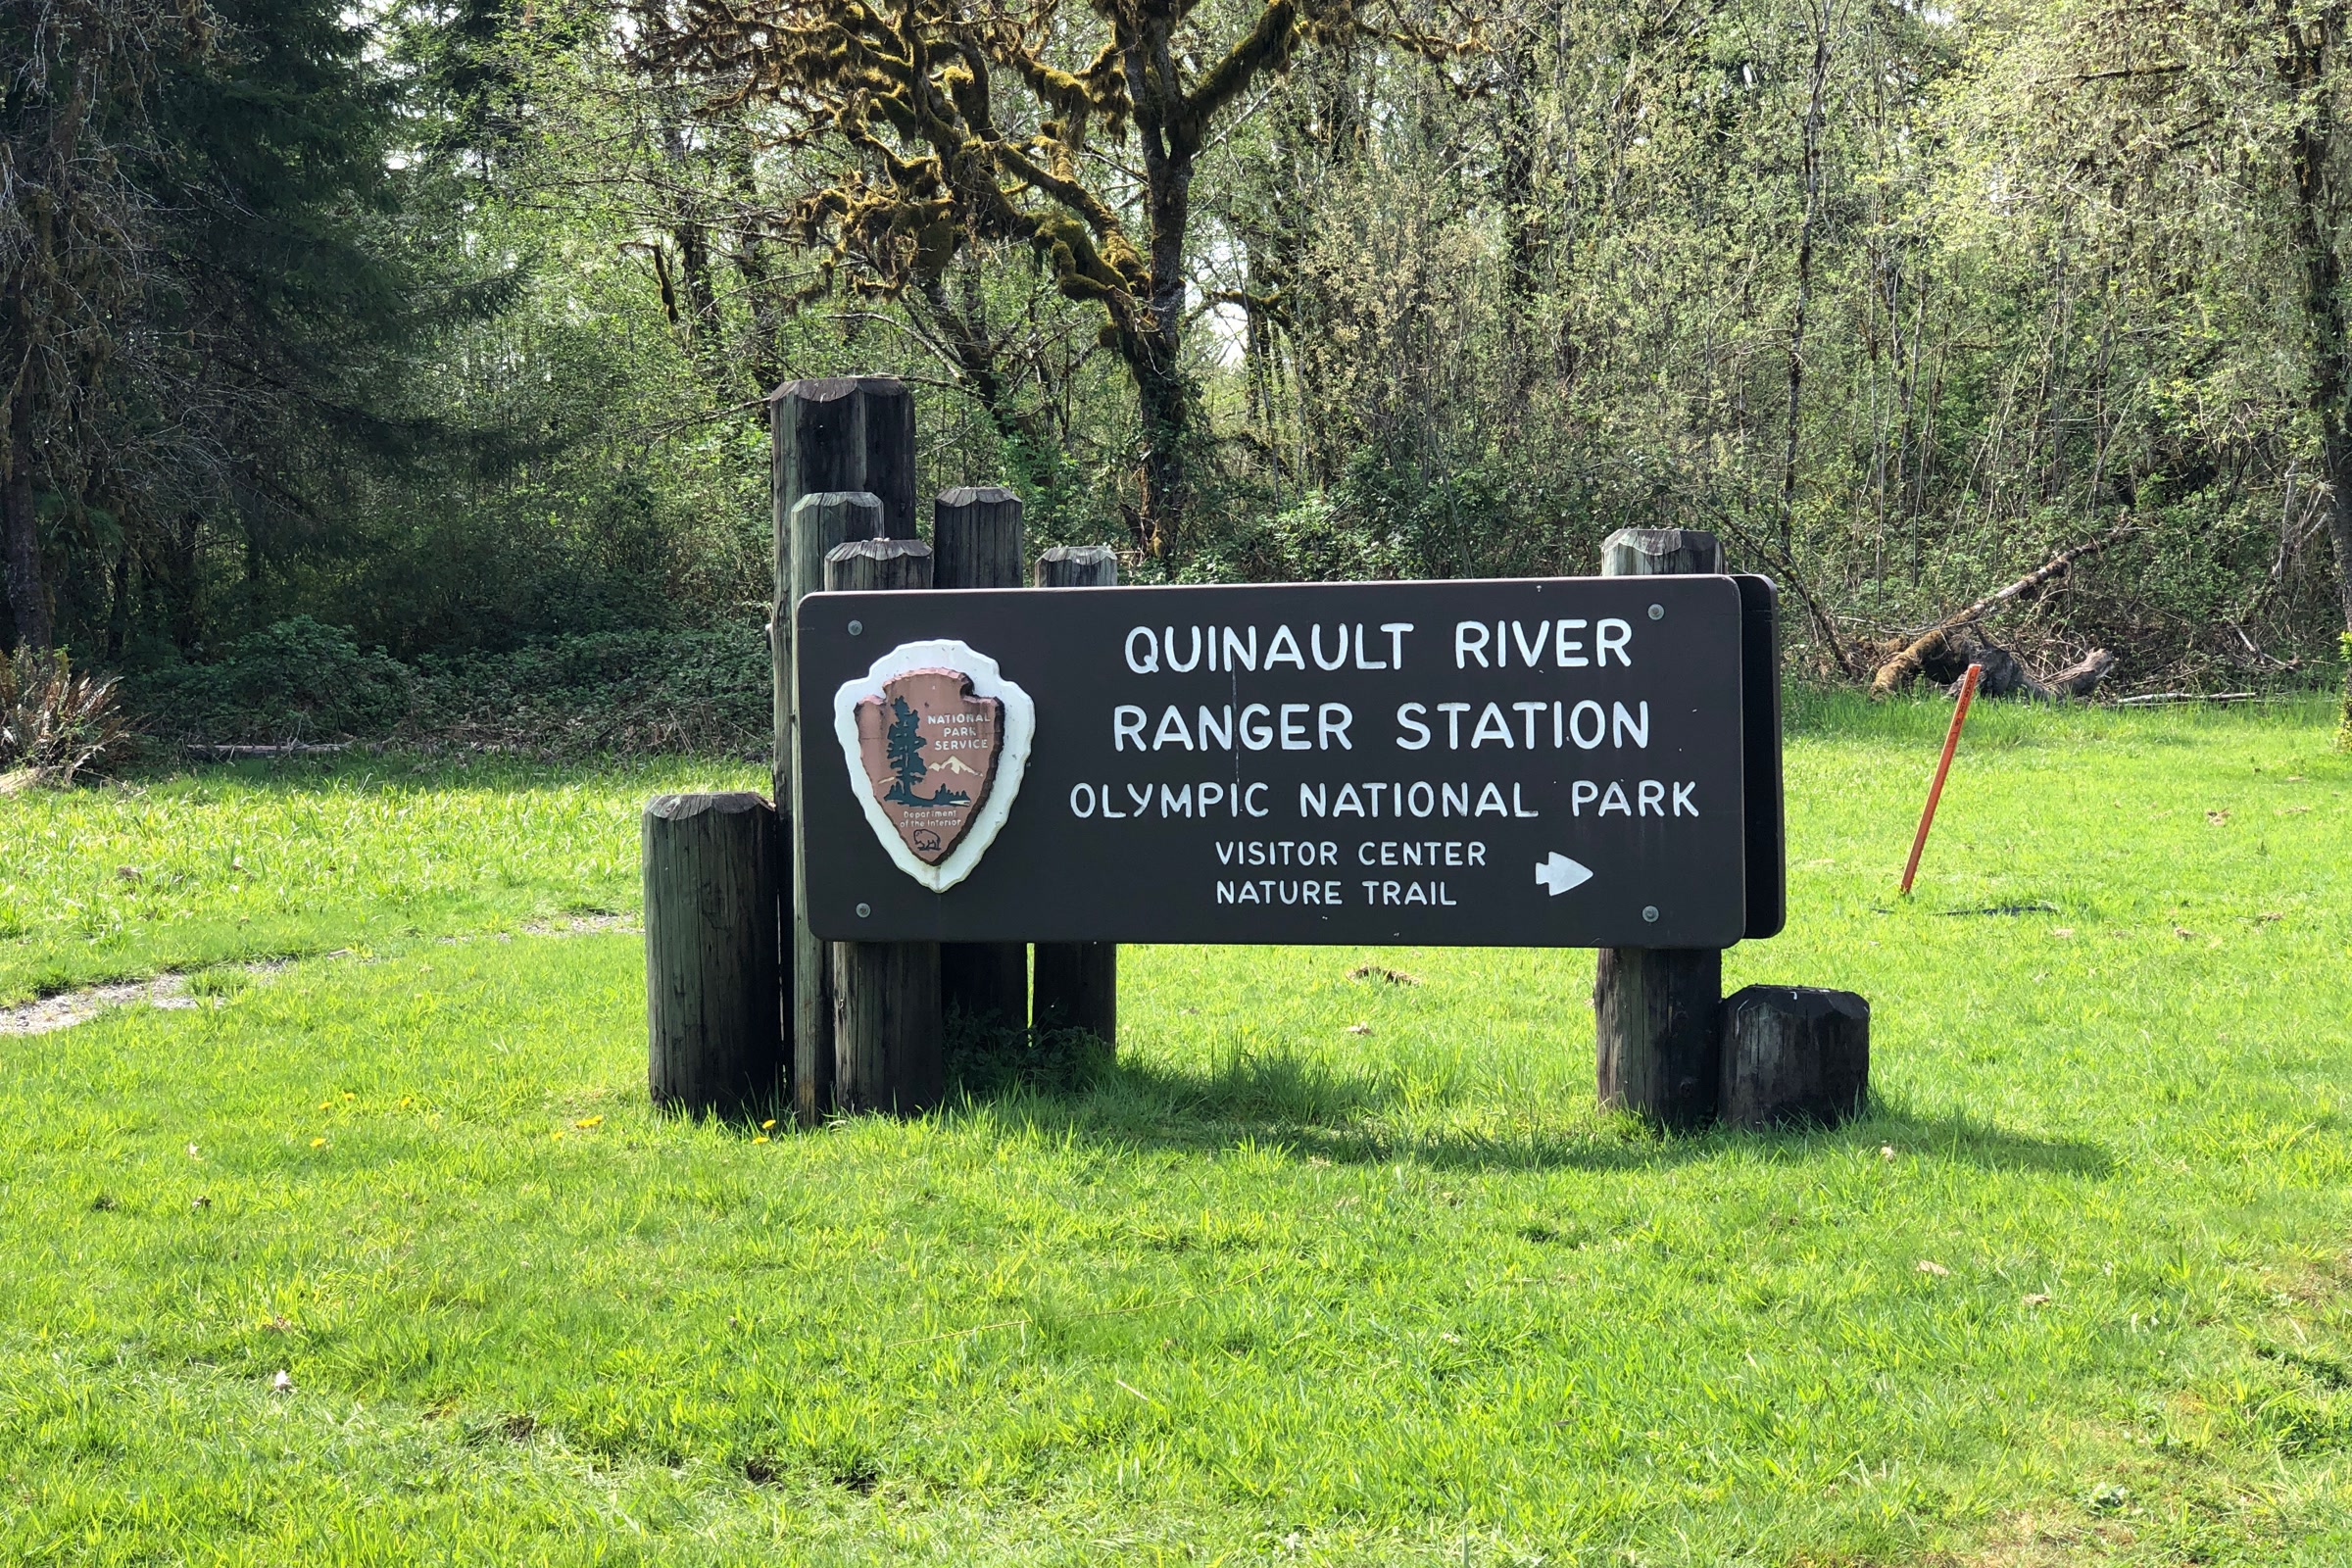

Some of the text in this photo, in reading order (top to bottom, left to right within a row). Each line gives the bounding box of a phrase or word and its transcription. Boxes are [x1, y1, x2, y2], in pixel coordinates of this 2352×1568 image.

[1124, 617, 1633, 674] QUINAULT RIVER
[927, 713, 991, 723] NATIONAL
[1113, 699, 1649, 752] RANGER STATION
[944, 727, 977, 737] PARK
[935, 740, 989, 751] SERVICE
[1070, 779, 1699, 818] OLYMPIC NATIONAL PARK
[904, 809, 957, 819] Department
[900, 819, 961, 828] of the Interior
[1215, 841, 1486, 866] VISITOR CENTER
[1216, 880, 1457, 906] NATURE TRAIL
